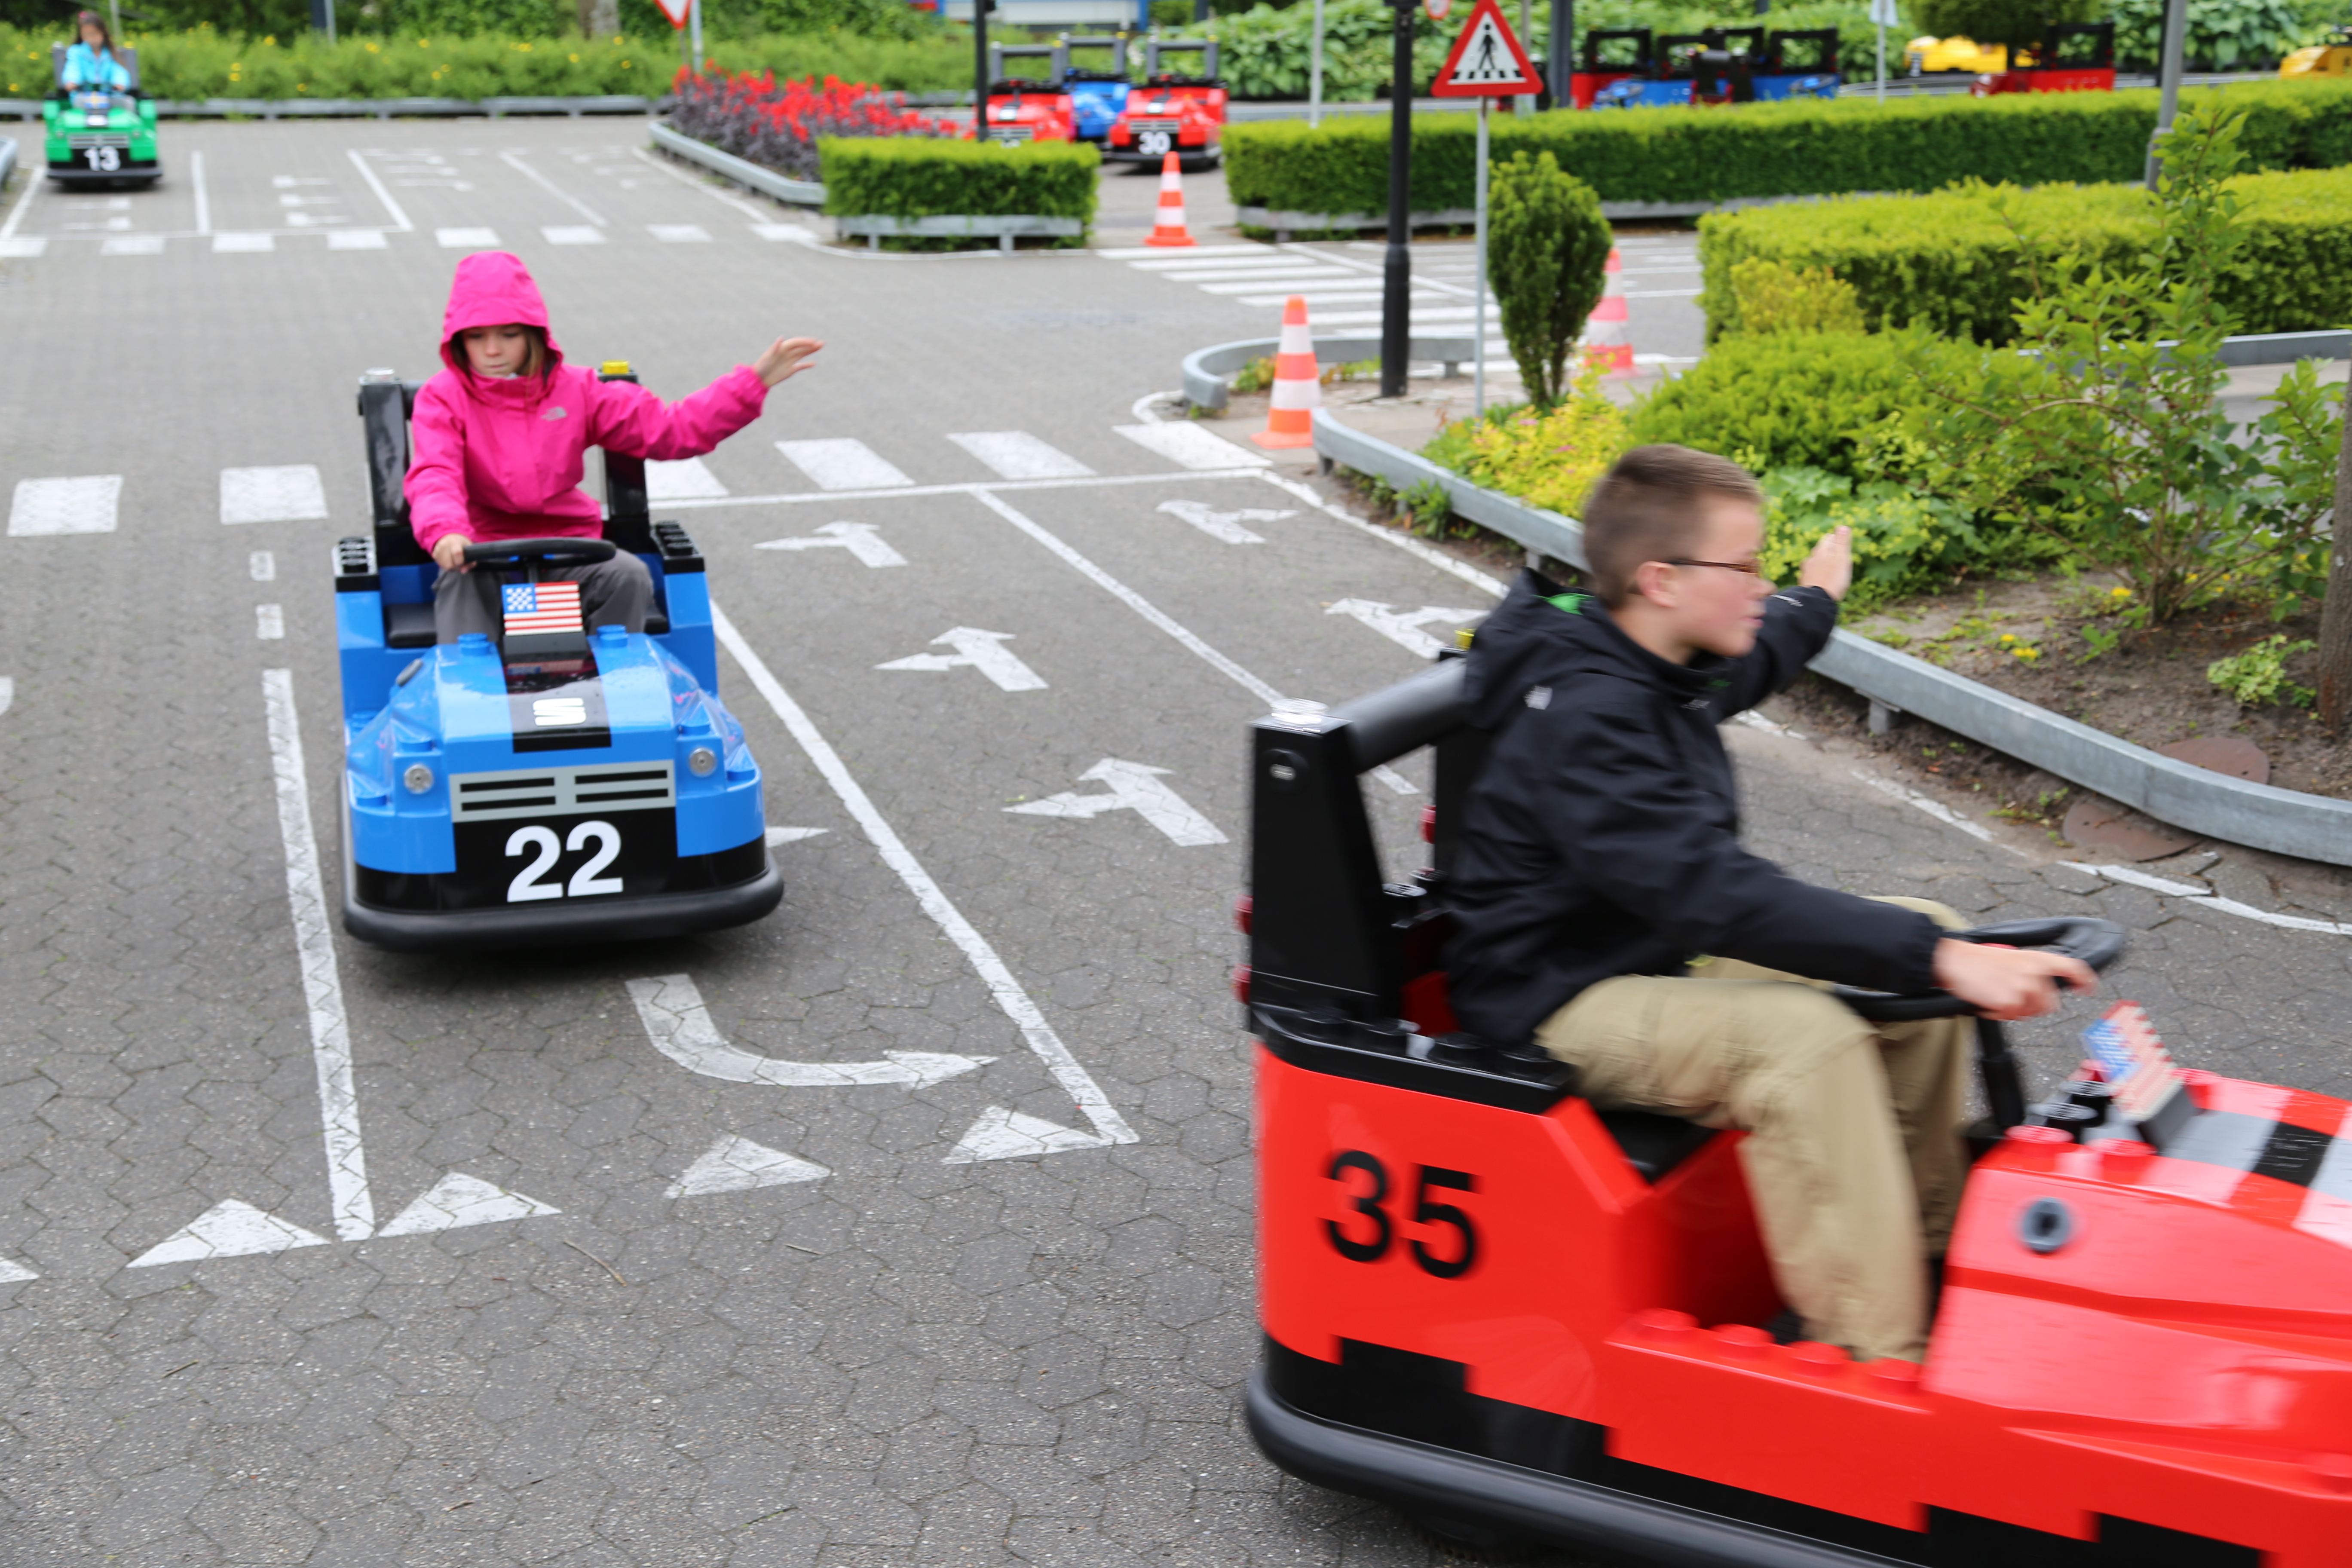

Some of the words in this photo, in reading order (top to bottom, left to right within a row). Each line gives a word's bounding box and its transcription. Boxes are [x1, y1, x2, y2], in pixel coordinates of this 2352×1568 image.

[84, 146, 120, 171] 13
[1139, 131, 1171, 155] 30
[505, 820, 624, 903] 22
[1320, 1148, 1481, 1280] 35
